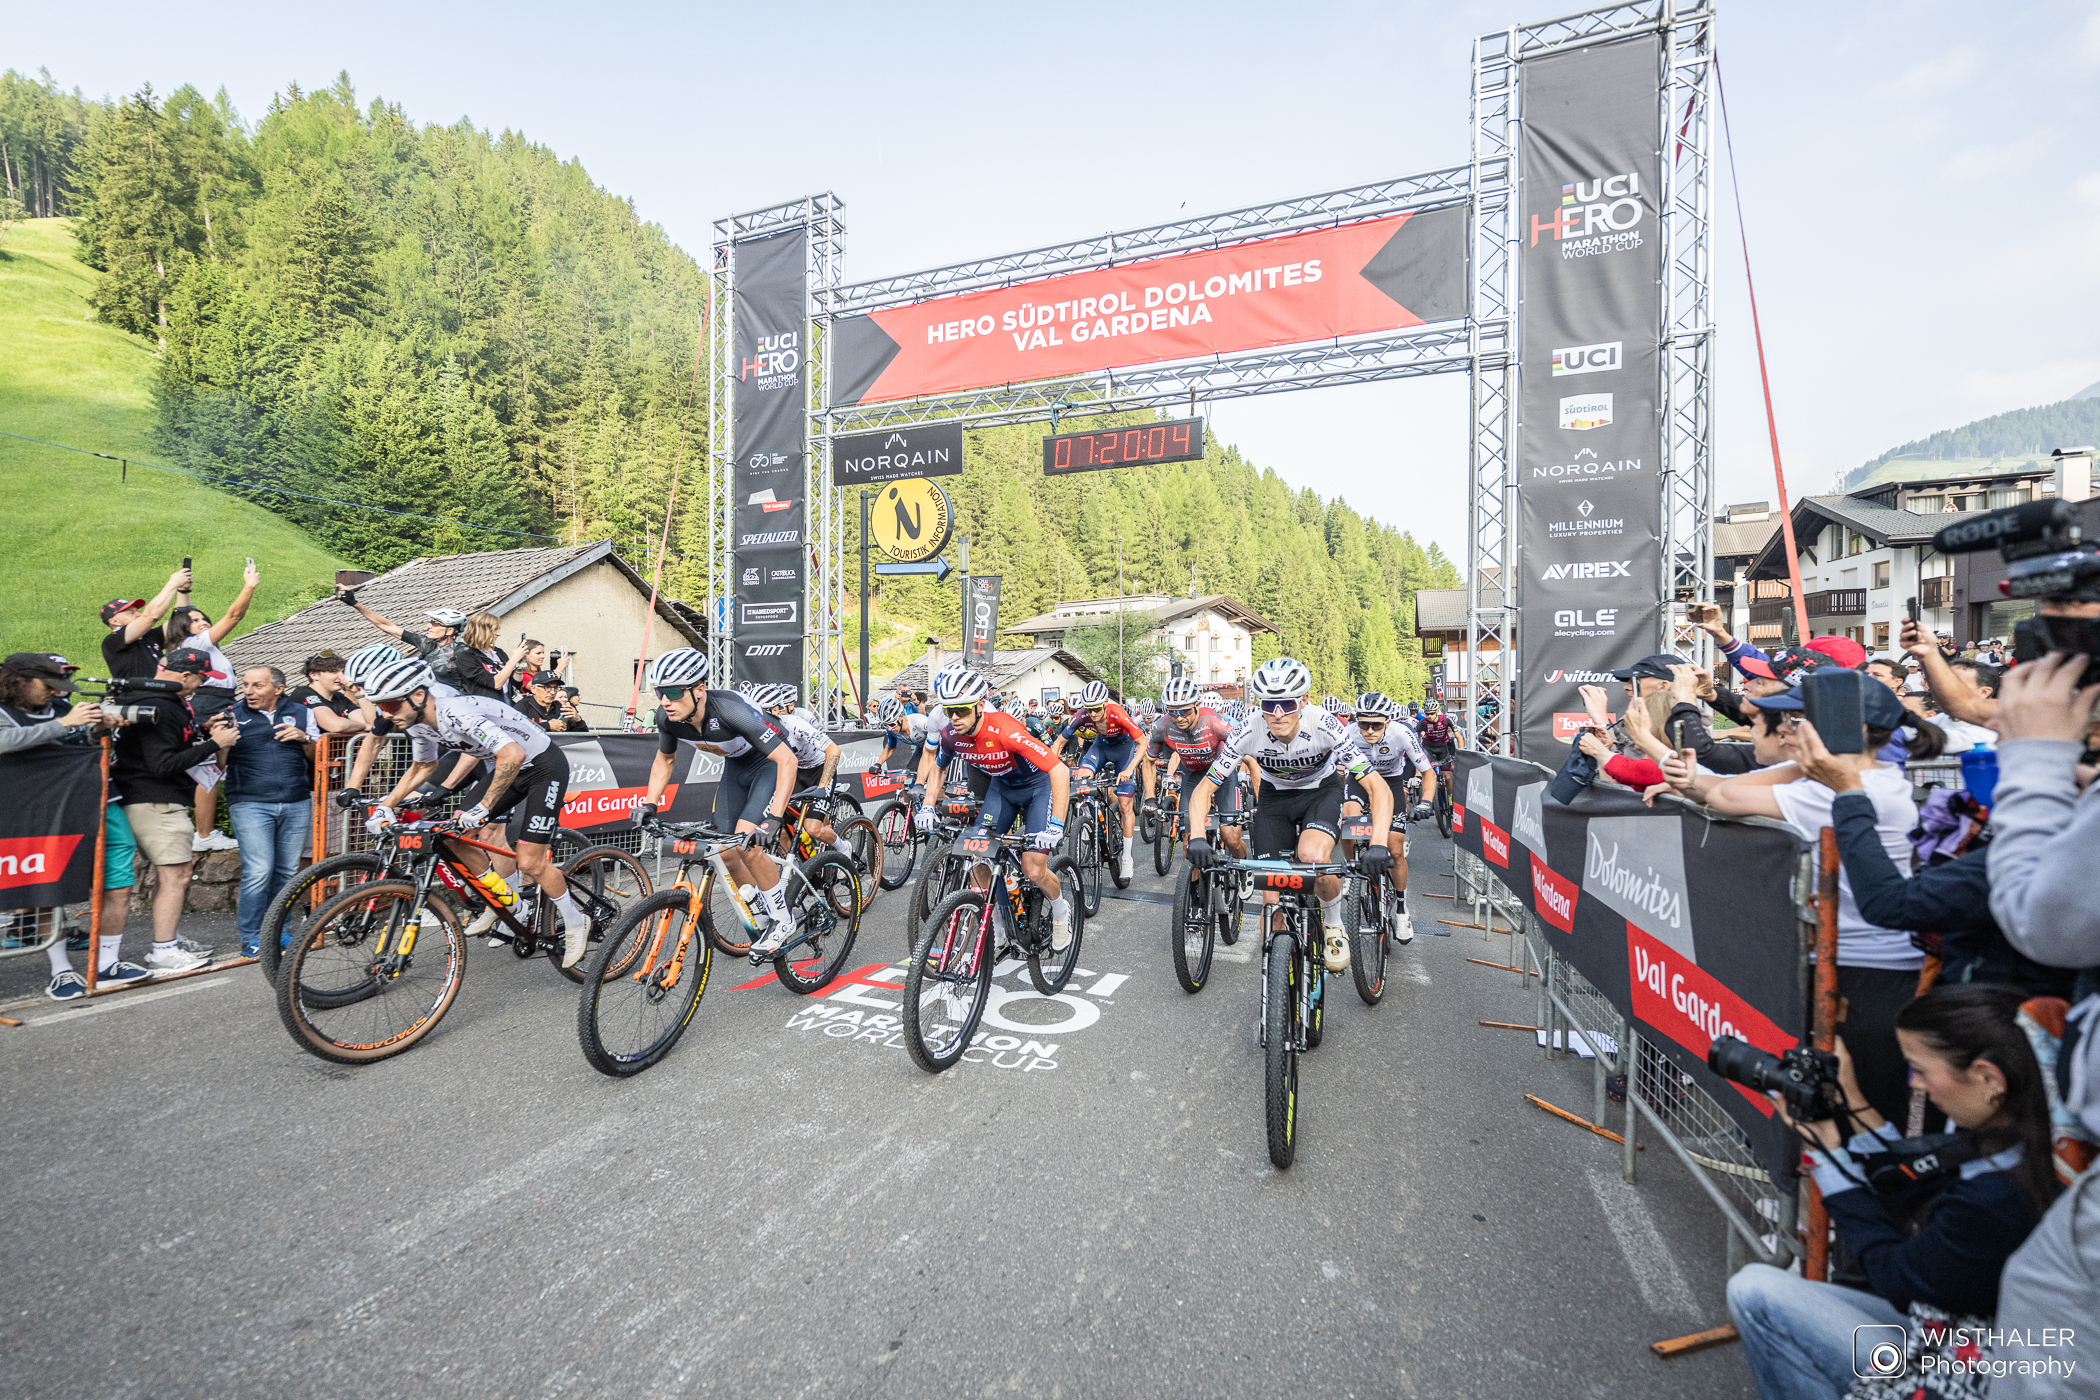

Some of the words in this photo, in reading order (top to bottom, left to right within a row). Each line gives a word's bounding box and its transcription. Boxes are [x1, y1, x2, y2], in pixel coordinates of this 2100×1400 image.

[1576, 172, 1638, 203] UCI
[1531, 197, 1643, 248] HERO
[1562, 231, 1640, 252] MARATHON
[1562, 244, 1612, 259] WORLD
[1615, 239, 1643, 251] CUP
[927, 315, 996, 344] HERO
[1002, 291, 1136, 331] SÜDTIROL
[1144, 260, 1323, 305] DOLOMITES
[1012, 331, 1063, 352] VAL
[1071, 303, 1213, 343] GARDENA
[765, 332, 798, 351] UCI
[742, 350, 799, 382] HERO
[1564, 347, 1616, 370] UCI
[758, 373, 797, 386] MARATHON
[758, 382, 783, 391] WORLD
[784, 379, 799, 387] CUP
[1054, 424, 1191, 469] 07:20:04
[845, 448, 949, 473] NORQAIN
[1533, 458, 1641, 478] NORQAIN
[889, 544, 930, 560] TOURISTIK
[926, 486, 947, 548] INFORMATION
[1549, 518, 1624, 531] MILLENNIUM
[1579, 529, 1623, 537] PROPERTIES
[740, 530, 799, 545] SPECIALIZED
[1541, 560, 1632, 580] AVIREX
[1554, 628, 1615, 638] alecycling.com
[745, 644, 791, 656] DMT
[1022, 738, 1048, 758] KENDA
[1219, 758, 1231, 769] LG
[545, 780, 560, 810] KTM
[564, 798, 592, 815] Val
[598, 793, 666, 812] Gardea
[947, 803, 969, 813] 104
[529, 815, 555, 831] SLP
[1350, 825, 1374, 837] 150
[399, 835, 422, 849] 106
[673, 839, 697, 854] 101
[963, 838, 990, 852] 103
[1482, 826, 1490, 846] Val
[1490, 831, 1508, 861] Gardena
[1266, 871, 1303, 890] 108
[1589, 831, 1681, 928] Dolomites
[1533, 865, 1541, 894] Val
[1541, 875, 1570, 921] Gardena
[1634, 946, 1667, 1000] Val
[961, 1047, 1058, 1073] CUP
